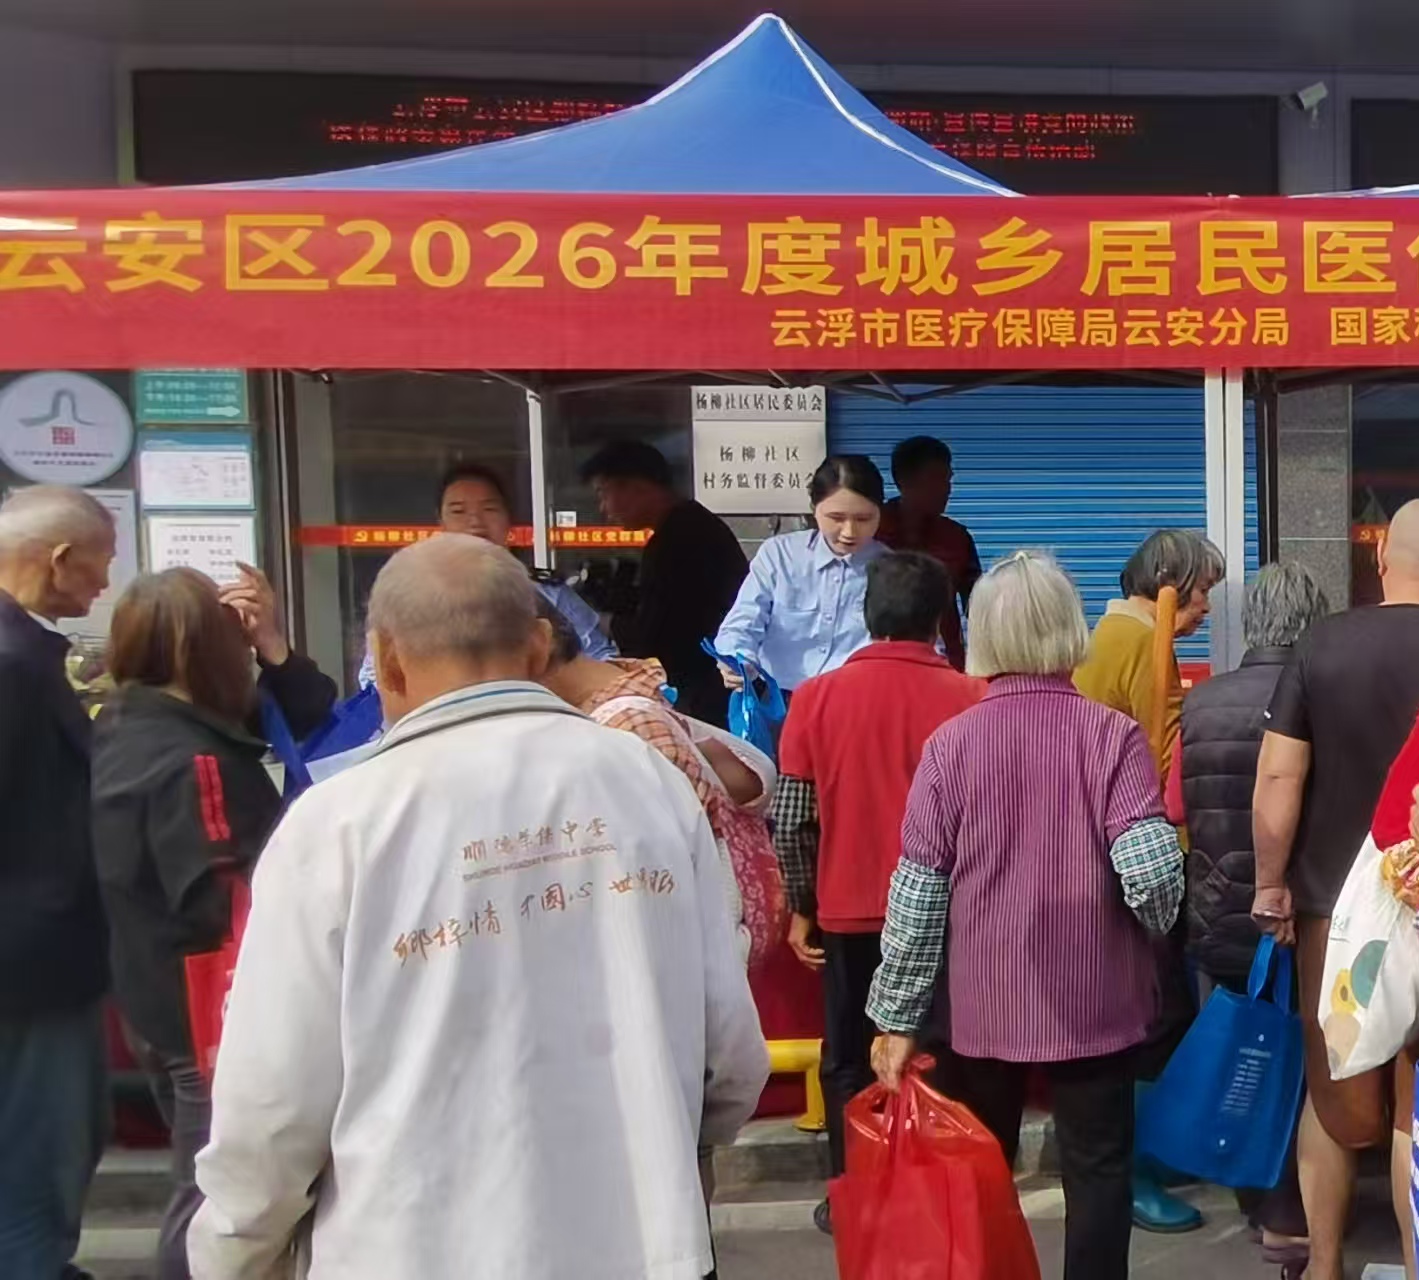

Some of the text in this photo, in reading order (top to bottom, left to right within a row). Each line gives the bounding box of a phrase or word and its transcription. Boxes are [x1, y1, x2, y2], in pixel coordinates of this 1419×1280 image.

[770, 307, 1290, 348] 云浮市医疗保障局云安分局
[696, 391, 823, 411] 杨柳社区居民委员会
[720, 446, 800, 462] 杨柳社区
